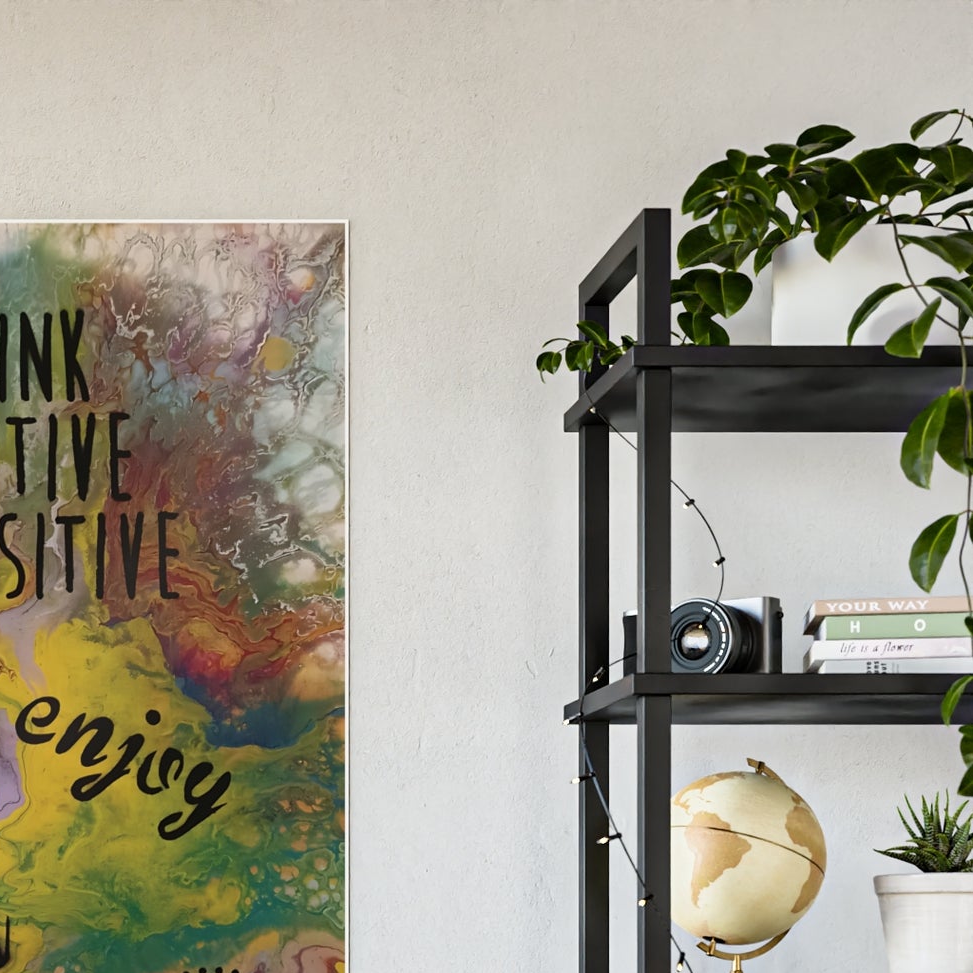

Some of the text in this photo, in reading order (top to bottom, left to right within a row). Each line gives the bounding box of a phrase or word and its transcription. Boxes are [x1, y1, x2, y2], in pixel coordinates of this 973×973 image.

[826, 600, 929, 613] YOUR WAY
[840, 642, 856, 656] life
[860, 645, 868, 653] is
[880, 641, 914, 656] flower
[15, 696, 231, 841] enjoy
